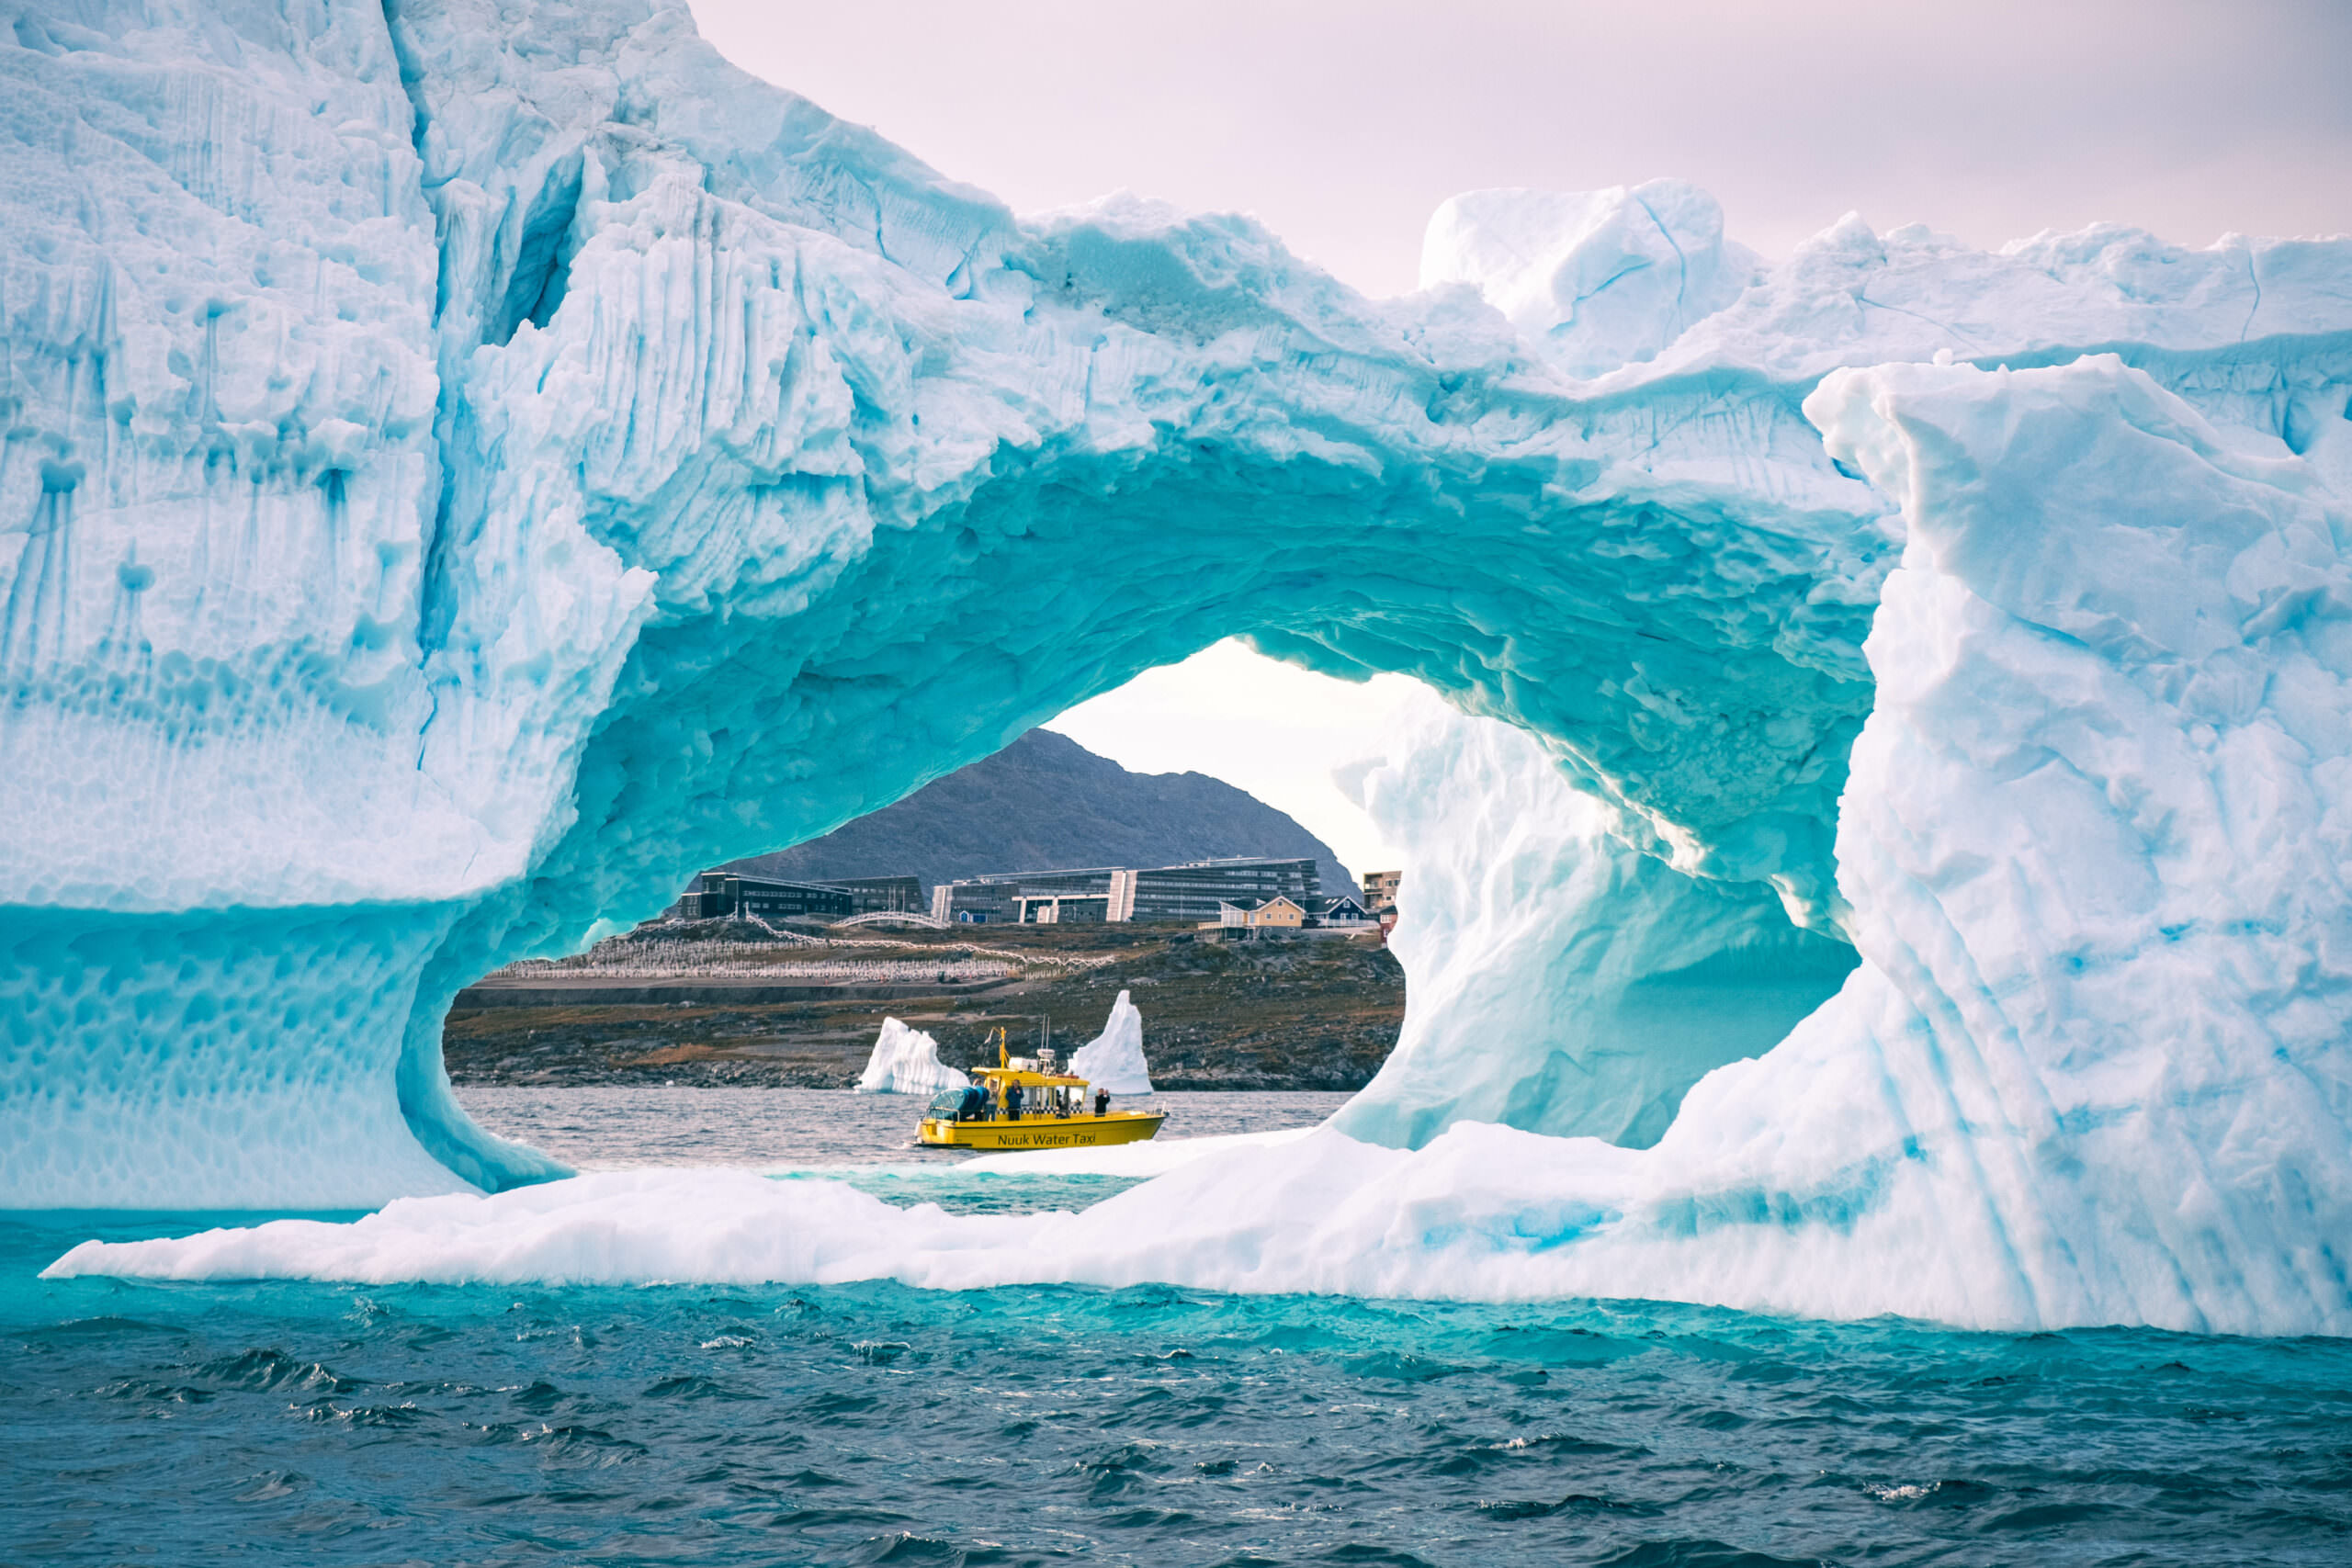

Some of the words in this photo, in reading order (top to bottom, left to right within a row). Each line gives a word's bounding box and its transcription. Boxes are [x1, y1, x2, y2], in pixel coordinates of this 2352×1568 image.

[998, 1134, 1029, 1145] Nuuk
[1033, 1134, 1070, 1145] Water
[1072, 1133, 1096, 1145] Taxi
